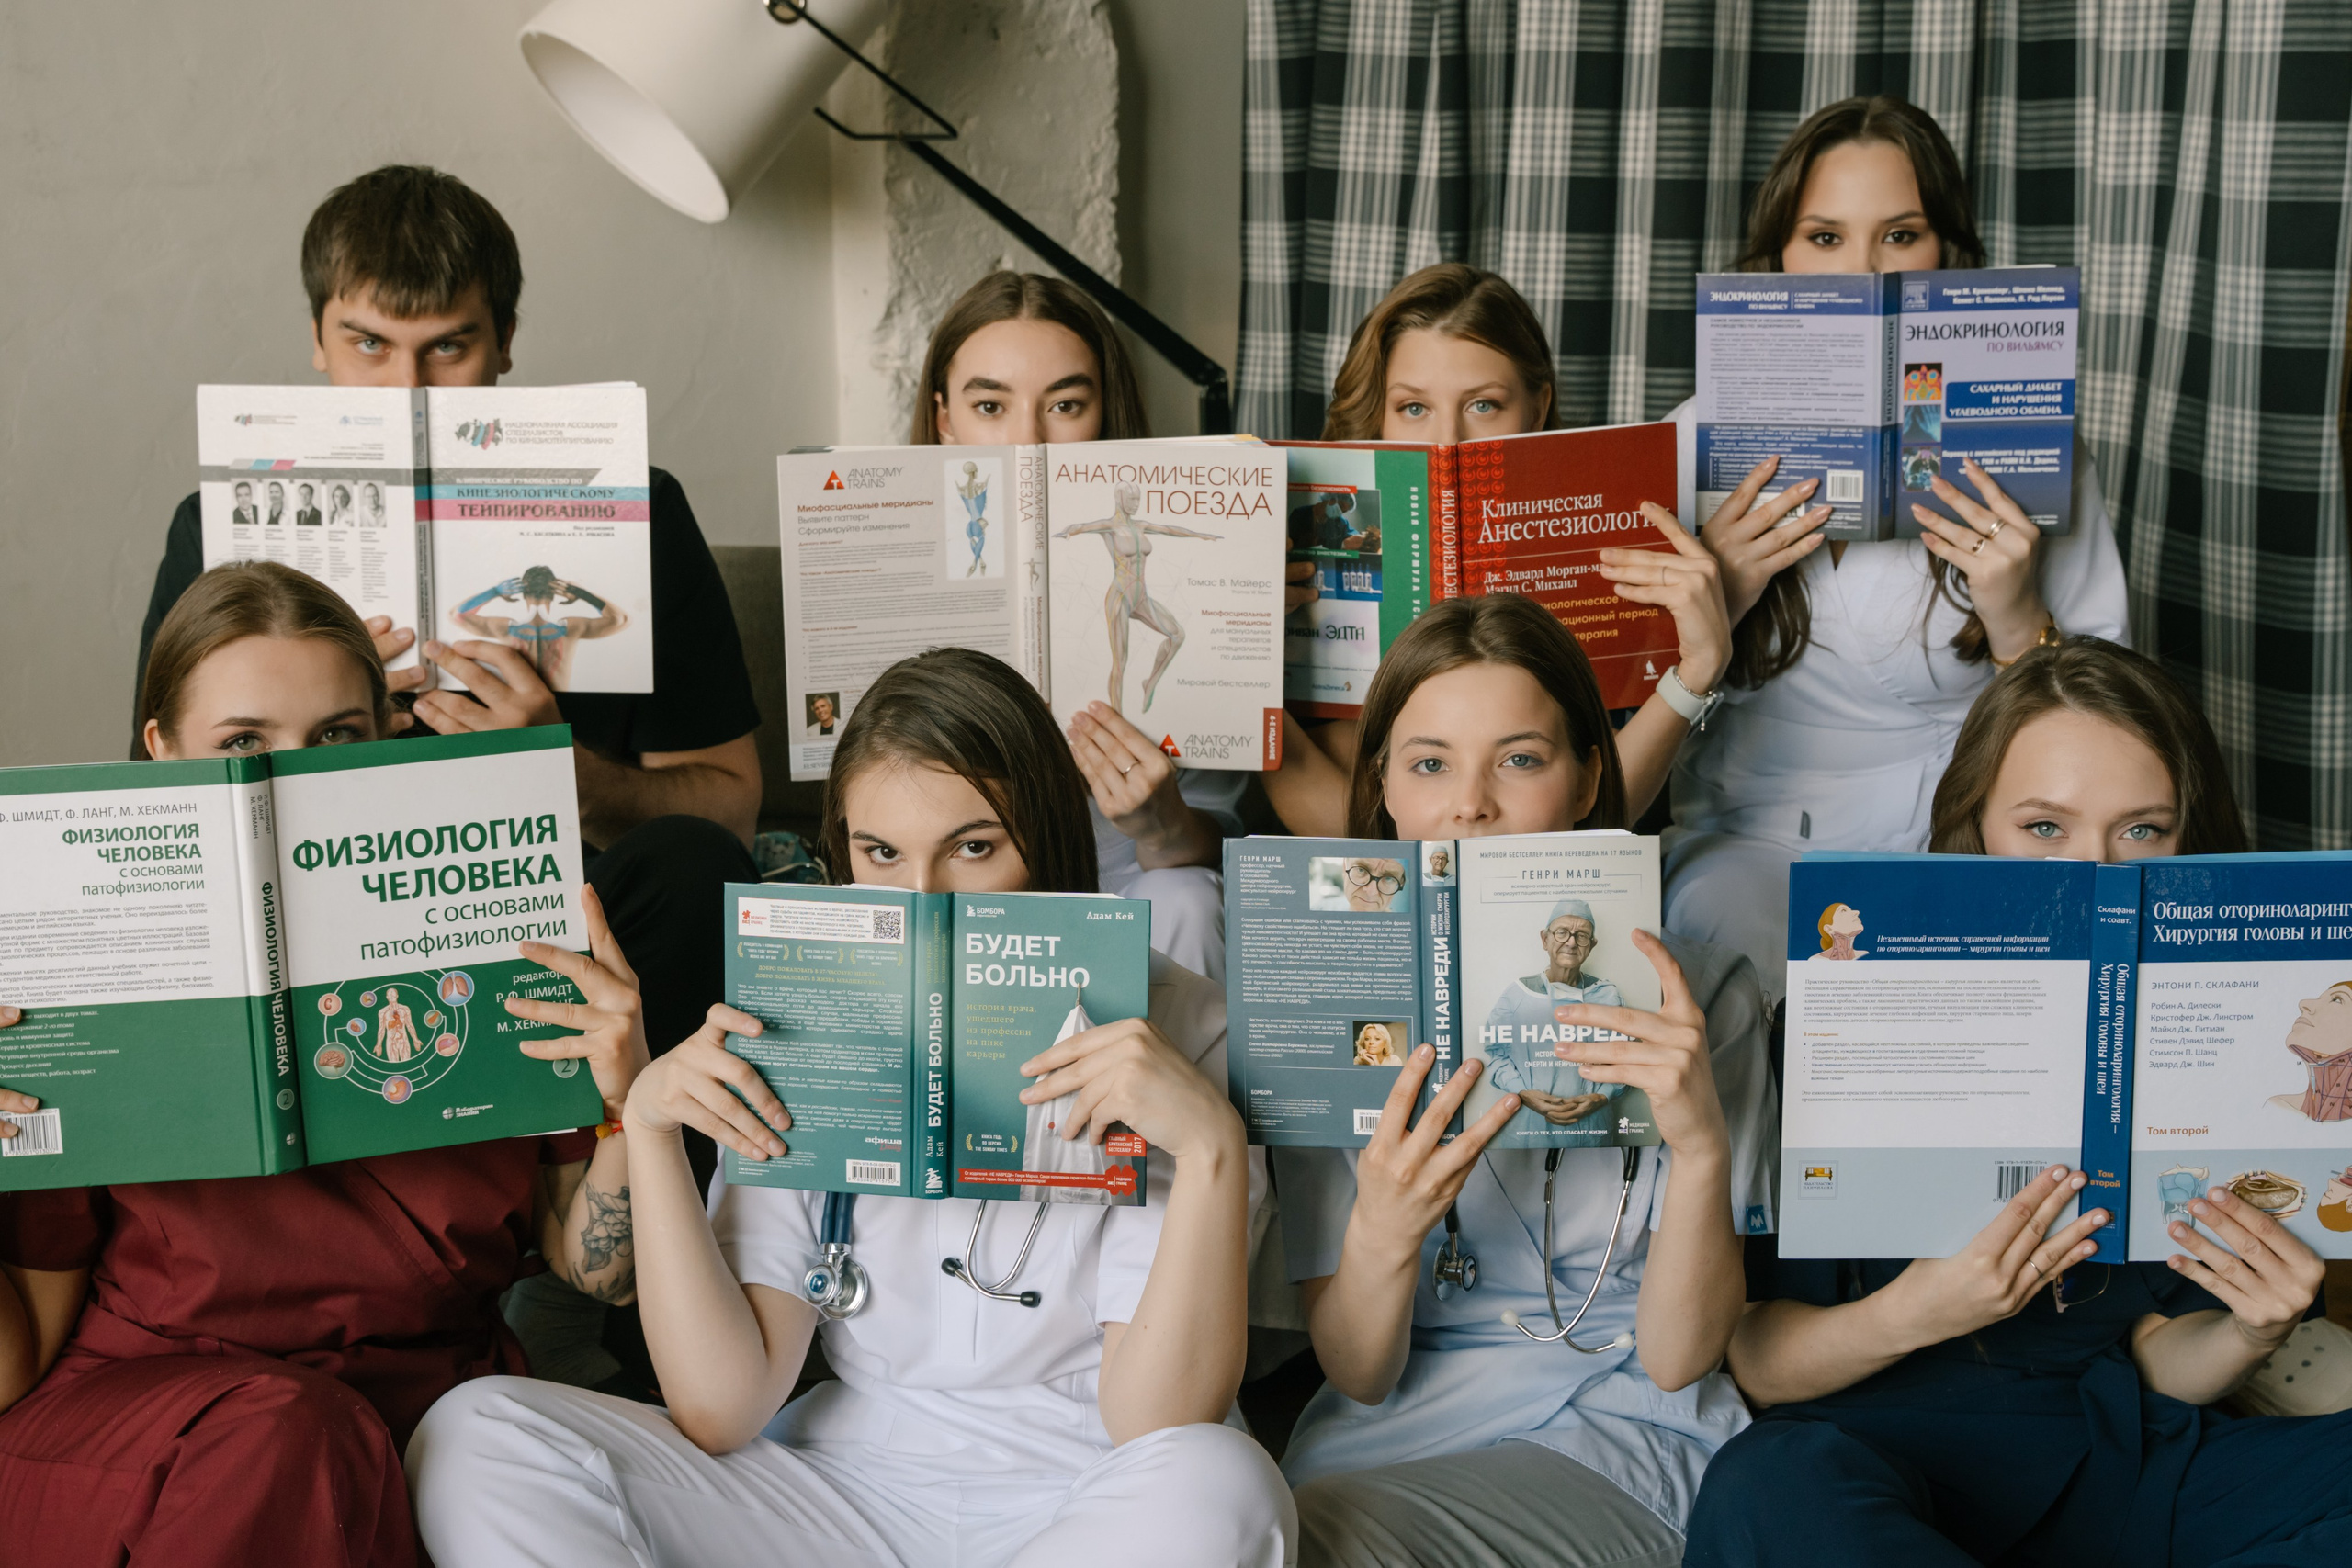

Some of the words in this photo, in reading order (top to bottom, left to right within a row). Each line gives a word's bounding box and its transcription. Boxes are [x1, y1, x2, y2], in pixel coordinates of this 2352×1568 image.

[1710, 291, 1789, 302] ЭНДОКРИНОЛОГИЯ
[1905, 321, 2064, 341] ЭНДОКРИНОЛОГИЯ
[1986, 342, 2004, 353] ПО
[2007, 341, 2064, 352] ВИЛЬЯМСУ
[1970, 382, 2023, 394] САХАРНЫЙ
[2024, 382, 2063, 392] ДИАБЕТ
[1992, 395, 2000, 404] И
[2001, 393, 2063, 404] НАРУШЕНИЯ
[1949, 406, 2018, 417] УГЛЕВОДНОГО
[2019, 405, 2062, 415] ОБМЕНА
[518, 436, 614, 445] КИНЕЗИОТЕЙПИРОВАНИЮ
[847, 466, 903, 479] ANATOMY
[1055, 463, 1272, 487] АНАТОМИЧЕСКИЕ
[847, 478, 886, 490] TRAINS
[1019, 456, 1034, 523] ПОЕЗДА
[457, 488, 616, 498] КИНЕЗИОЛОГИЧЕСКОМУ
[457, 502, 616, 518] ТЕЙПИРОВАНИЮ
[797, 502, 879, 513] Миофасциальные
[881, 499, 934, 510] меридианы
[1034, 456, 1045, 551] АНАТОМИЧЕСКИЕ
[1146, 490, 1272, 520] ПОЕЗДА
[1409, 486, 1419, 525] НОВАЯ
[1481, 493, 1603, 519] Клиническая
[797, 515, 832, 525] Выявите
[833, 513, 870, 524] паттерн
[1477, 507, 1670, 545] Анестезиолог
[797, 525, 861, 536] Сформируйте
[862, 523, 910, 532] изменения
[1442, 488, 1458, 600] ЕСТЕЗИОЛОГИЯ
[1411, 533, 1421, 592] ФОРМУЛА
[1483, 571, 1503, 585] Дж.
[1505, 568, 1544, 582] Эдвард
[1546, 562, 1605, 578] Морган-м
[1187, 578, 1217, 587] Томас
[1219, 578, 1227, 587] В.
[1230, 579, 1272, 589] Майерс
[1521, 581, 1532, 593] С.
[1534, 579, 1577, 592] Михаил
[1201, 609, 1272, 618] Миофасциальные
[1618, 607, 1659, 622] период
[1177, 678, 1216, 688] Мировой
[1218, 679, 1271, 690] бестселлер
[1183, 734, 1253, 748] ANATOMY
[1183, 746, 1230, 759] TRAINS
[11, 808, 62, 823] ШМИДТ,
[65, 808, 80, 820] Ф.
[82, 807, 117, 819] ЛАНГ,
[119, 805, 135, 817] М.
[137, 802, 198, 816] ХЕКМАНН
[62, 822, 200, 845] ФИЗИОЛОГИЯ
[292, 813, 559, 872] ФИЗИОЛОГИЯ
[96, 843, 202, 863] ЧЕЛОВЕКА
[1479, 851, 1508, 859] МИРОВОЙ
[119, 867, 129, 878] с
[130, 863, 204, 877] основами
[1521, 869, 1560, 880] ГЕНРИ
[1566, 868, 1601, 879] МАРШ
[362, 853, 563, 903] ЧЕЛОВЕКА
[81, 877, 205, 897] патофизиологии
[425, 908, 439, 925] с
[443, 893, 565, 923] основами
[977, 907, 1006, 916] БОМБОРА
[1086, 911, 1113, 920] Адам
[1114, 910, 1135, 920] Кей
[2097, 905, 2136, 916] Склафани
[2153, 901, 2213, 923] Общая
[261, 881, 282, 991] ФИЗИОЛОГИЯ
[360, 919, 568, 961] патофизиологии
[1876, 934, 1927, 943] Незаменимый
[1928, 934, 1960, 943] источник
[1961, 934, 2002, 944] справочной
[2003, 934, 2050, 945] информации
[2153, 924, 2238, 946] Хирургия
[2244, 926, 2305, 942] головы
[2310, 926, 2322, 940] и
[966, 932, 1061, 960] БУДЕТ
[966, 964, 1091, 989] БОЛЬНО
[1433, 936, 1452, 1030] НАВРЕДИ
[2116, 964, 2131, 1002] Общая
[2099, 963, 2114, 1017] Хирургия
[2151, 981, 2192, 990] ЭНТОНИ
[2194, 981, 2204, 989] П.
[2205, 980, 2260, 990] СКЛАФАНИ
[496, 992, 505, 1003] Р.
[524, 983, 573, 999] ШМИДТ
[967, 1003, 1005, 1013] история
[1007, 1004, 1036, 1014] врача,
[2187, 1001, 2222, 1010] Дилески
[967, 1016, 1015, 1024] ушедшего
[2150, 1013, 2196, 1022] Кристофер
[2196, 1014, 2212, 1022] Дж.
[2212, 1013, 2254, 1021] Линстром
[270, 993, 290, 1077] ЧЕЛОВЕКА
[928, 992, 943, 1066] БОЛЬНО
[980, 1027, 1032, 1037] профессии
[1478, 1024, 1513, 1043] НЕ
[1521, 1023, 1639, 1043] НАВРЕД
[2150, 1025, 2177, 1033] Майкл
[2177, 1025, 2193, 1034] Дж.
[2194, 1025, 2225, 1033] Питман
[967, 1038, 978, 1046] на
[980, 1039, 1004, 1047] пике
[2098, 1019, 2109, 1059] головы
[2149, 1037, 2177, 1045] Стивен
[2179, 1037, 2204, 1045] Дэвид
[2206, 1036, 2235, 1045] Шефер
[1435, 1033, 1451, 1061] НЕ
[2149, 1049, 2184, 1057] Стимсон
[2195, 1048, 2218, 1057] Шанц
[967, 1051, 1006, 1060] карьеры
[2098, 1061, 2107, 1069] и
[2110, 1004, 2126, 1124] оториноларингология
[2148, 1060, 2178, 1069] Эдвард
[2179, 1060, 2196, 1069] Дж.
[2197, 1060, 2215, 1068] Шин
[2096, 1070, 2107, 1095] шеи
[928, 1070, 944, 1128] БУДЕТ
[2146, 1126, 2168, 1136] Том
[2169, 1125, 2209, 1137] второй
[865, 1135, 902, 1145] афиша
[925, 1135, 933, 1157] Адам
[1134, 1136, 1142, 1154] 2017
[2097, 1169, 2115, 1179] Том
[2089, 1179, 2121, 1189] второй
